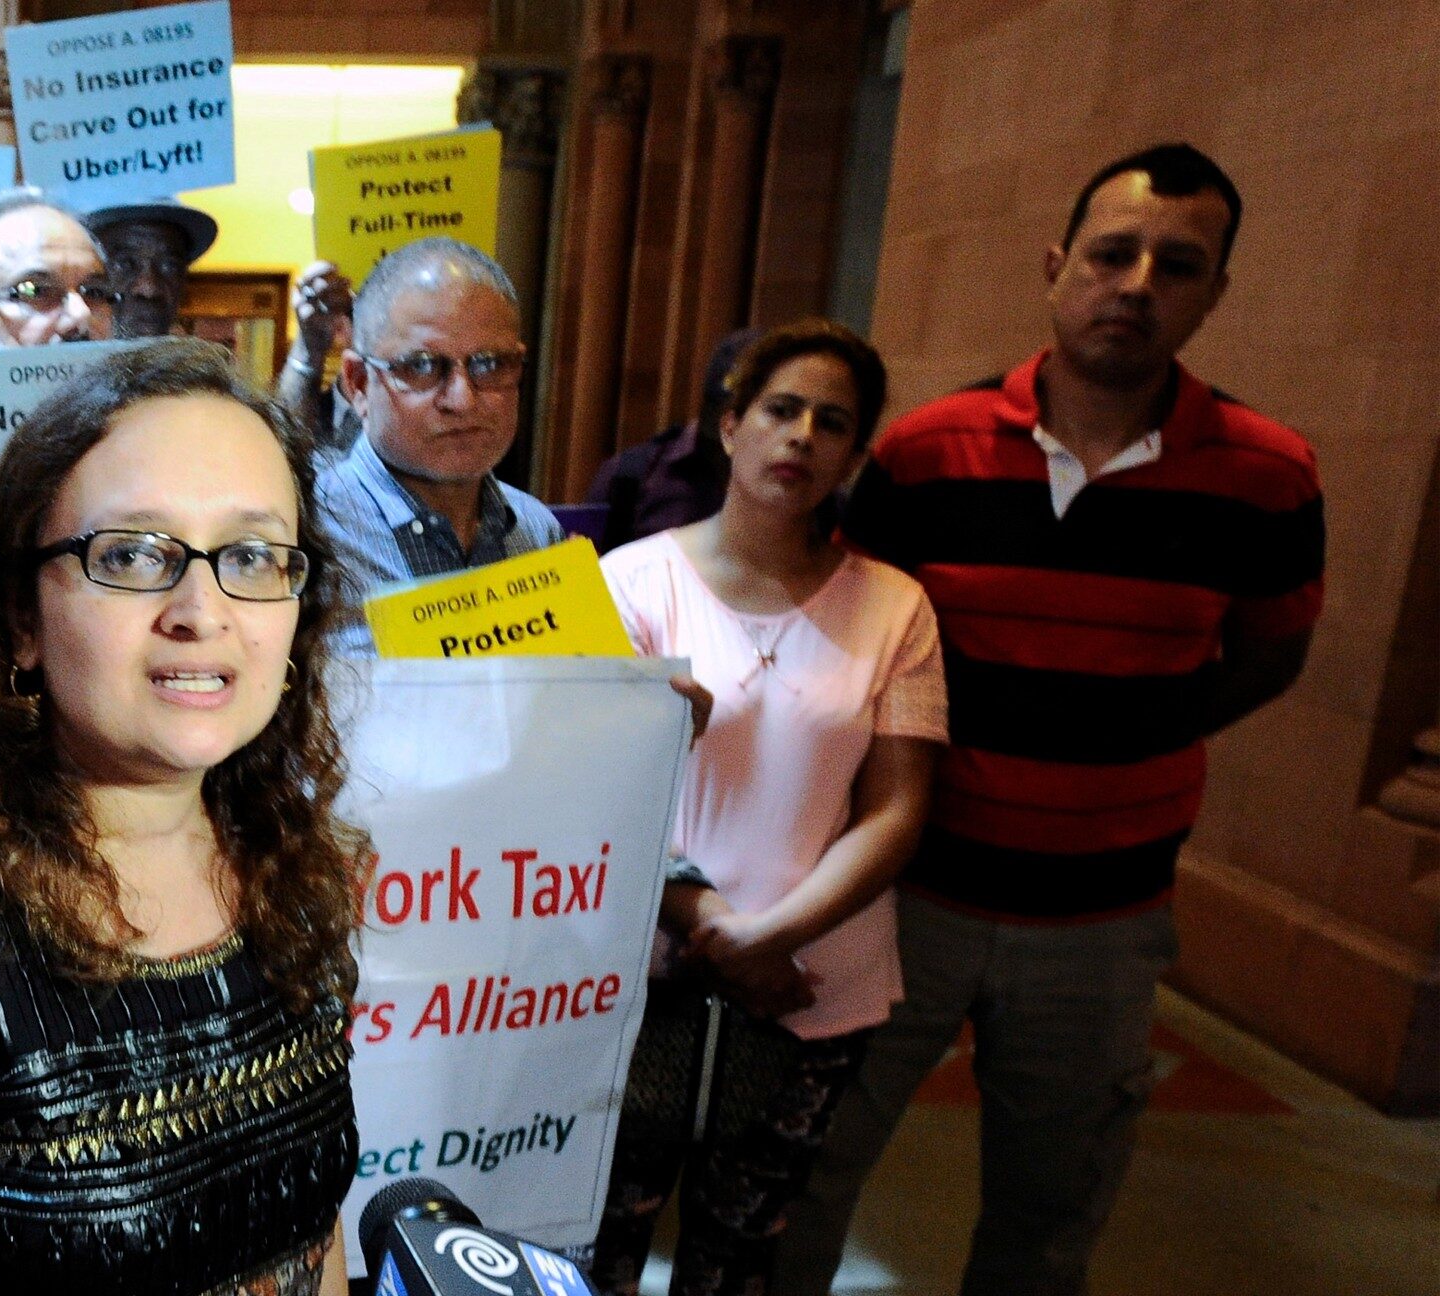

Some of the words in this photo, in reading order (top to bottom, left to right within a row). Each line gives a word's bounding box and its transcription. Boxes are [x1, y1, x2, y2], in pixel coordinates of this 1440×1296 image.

[48, 32, 113, 56] OPPOSE
[23, 76, 64, 99] No
[75, 57, 224, 92] Insurance
[30, 116, 116, 143] Carve
[127, 104, 177, 129] Out
[188, 98, 226, 120] for
[63, 140, 203, 182] Uber/Lyft!
[361, 176, 453, 200] Protect
[350, 212, 464, 234] Full-Time
[412, 591, 481, 624] OPPOSE
[507, 568, 562, 598] 08195
[439, 606, 559, 659] Protect
[501, 841, 611, 920] Taxi
[344, 1000, 396, 1043] rs
[410, 973, 622, 1040] Alliance
[356, 1138, 425, 1178] ect
[436, 1112, 577, 1173] Dignity
